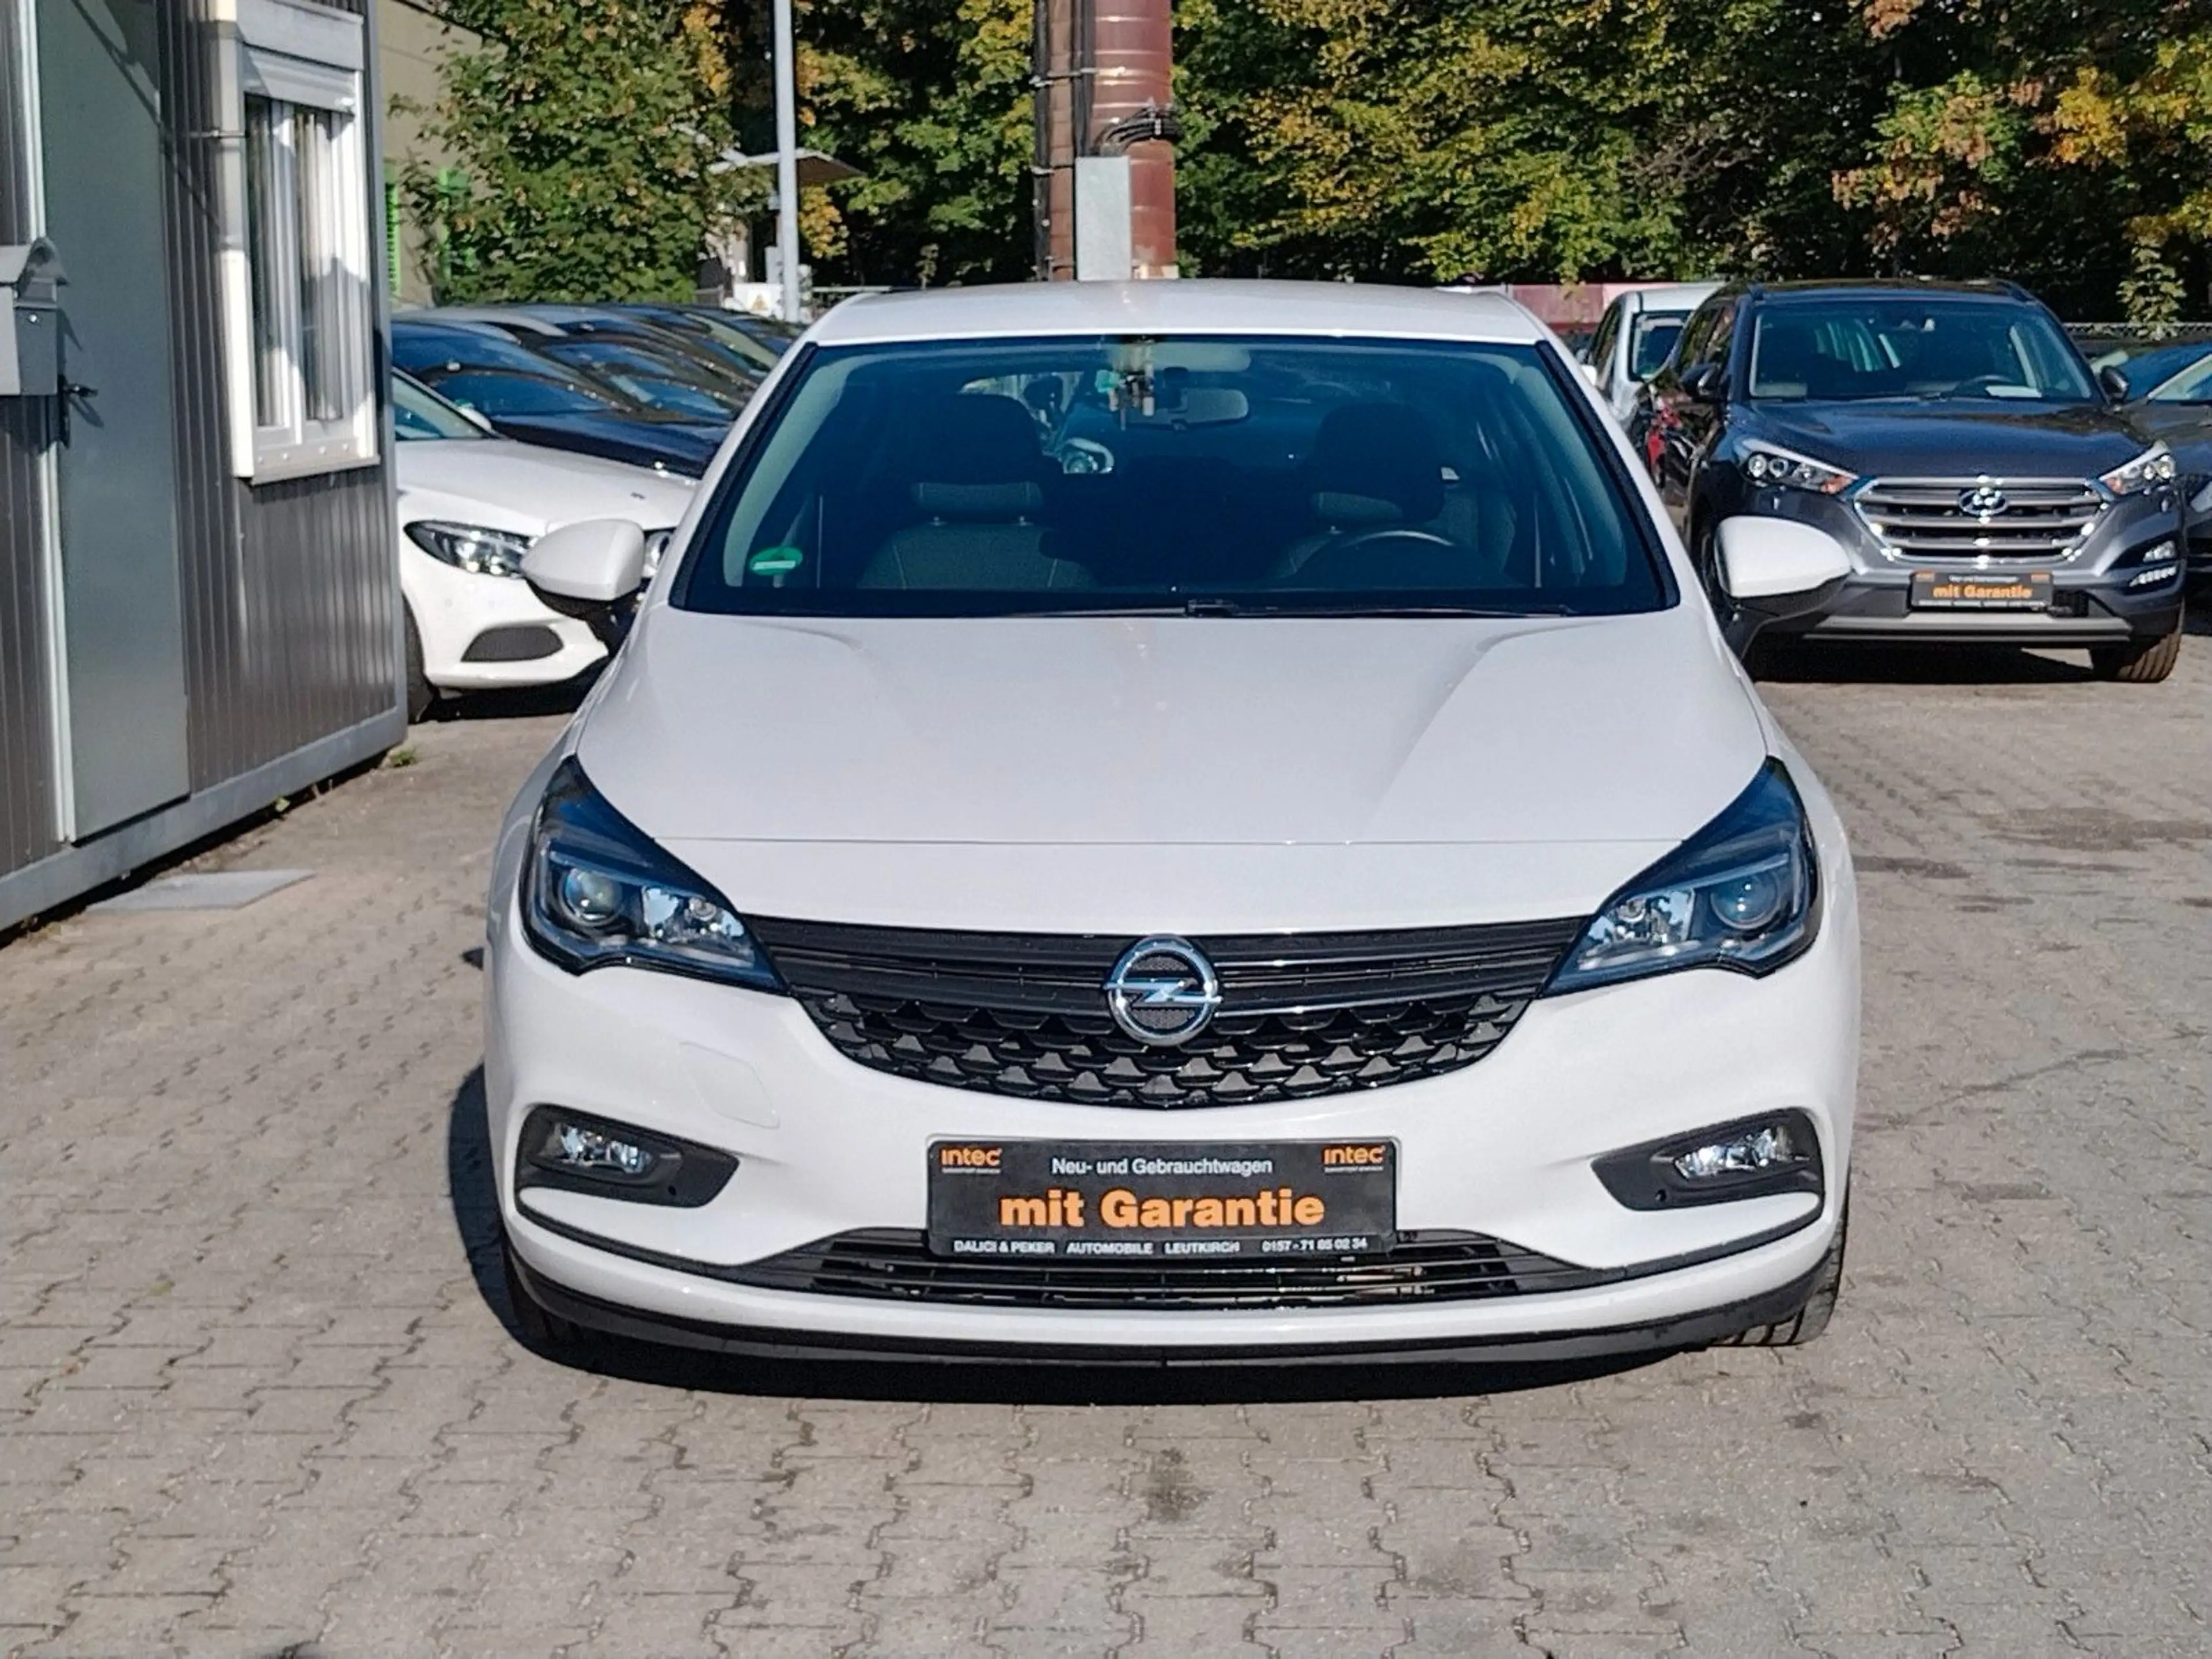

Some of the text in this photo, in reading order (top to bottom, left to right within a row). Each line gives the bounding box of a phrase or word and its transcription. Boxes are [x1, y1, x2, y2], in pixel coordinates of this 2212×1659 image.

[1933, 584, 2033, 599] mit Garantie
[941, 1147, 1002, 1166] intec
[1324, 1146, 1385, 1165] intec
[1051, 1157, 1273, 1177] Neu- und Gebrauchtwagen
[1000, 1187, 1325, 1228] mit Garantie
[998, 1241, 1009, 1253] &
[1010, 1241, 1055, 1254] PEKER
[1066, 1242, 1153, 1255] AUTOMOBILE
[1164, 1240, 1241, 1255] LEUTKIRCH
